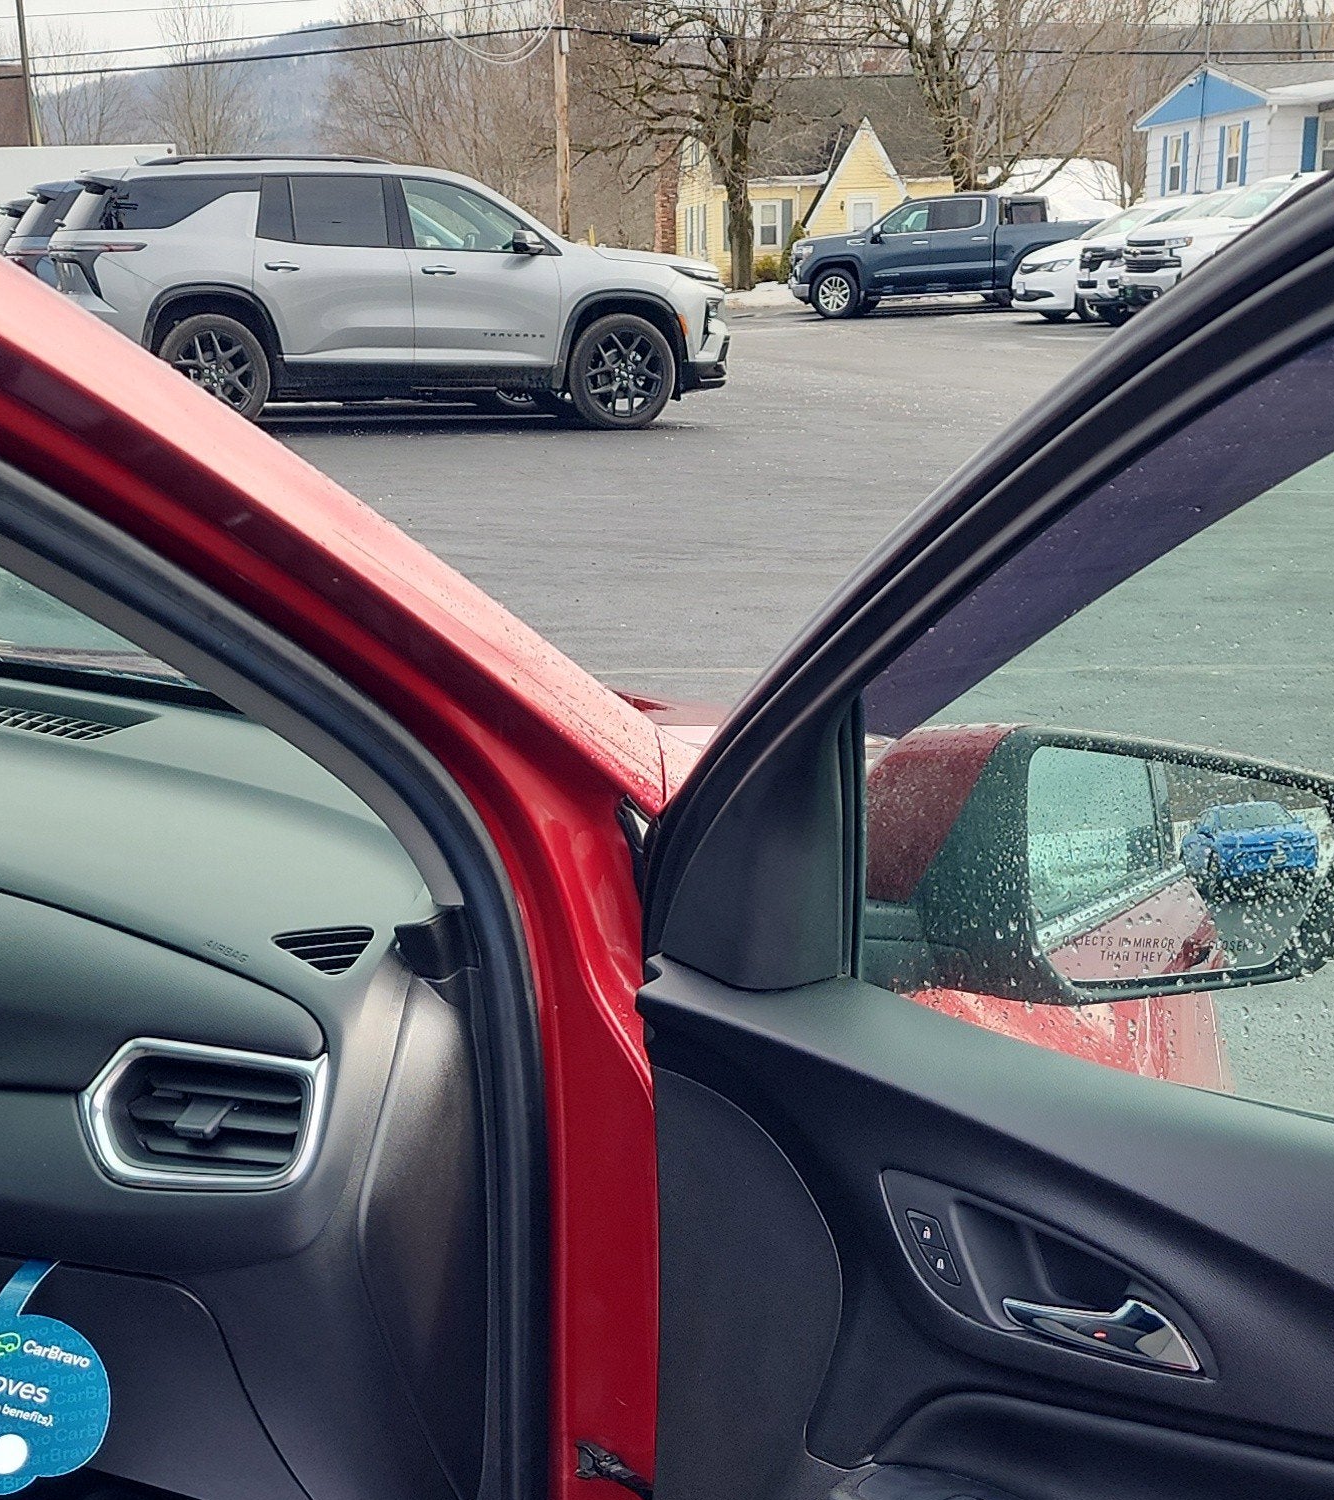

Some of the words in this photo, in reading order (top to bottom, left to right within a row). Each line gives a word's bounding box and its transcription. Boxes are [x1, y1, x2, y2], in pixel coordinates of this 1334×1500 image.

[202, 939, 250, 964] AIRBAG
[1063, 936, 1114, 947] OJECTS
[1133, 938, 1175, 950] MIRROR
[1101, 950, 1130, 962] THAN
[1135, 951, 1164, 963] THEY
[22, 1340, 91, 1368] CarBravo
